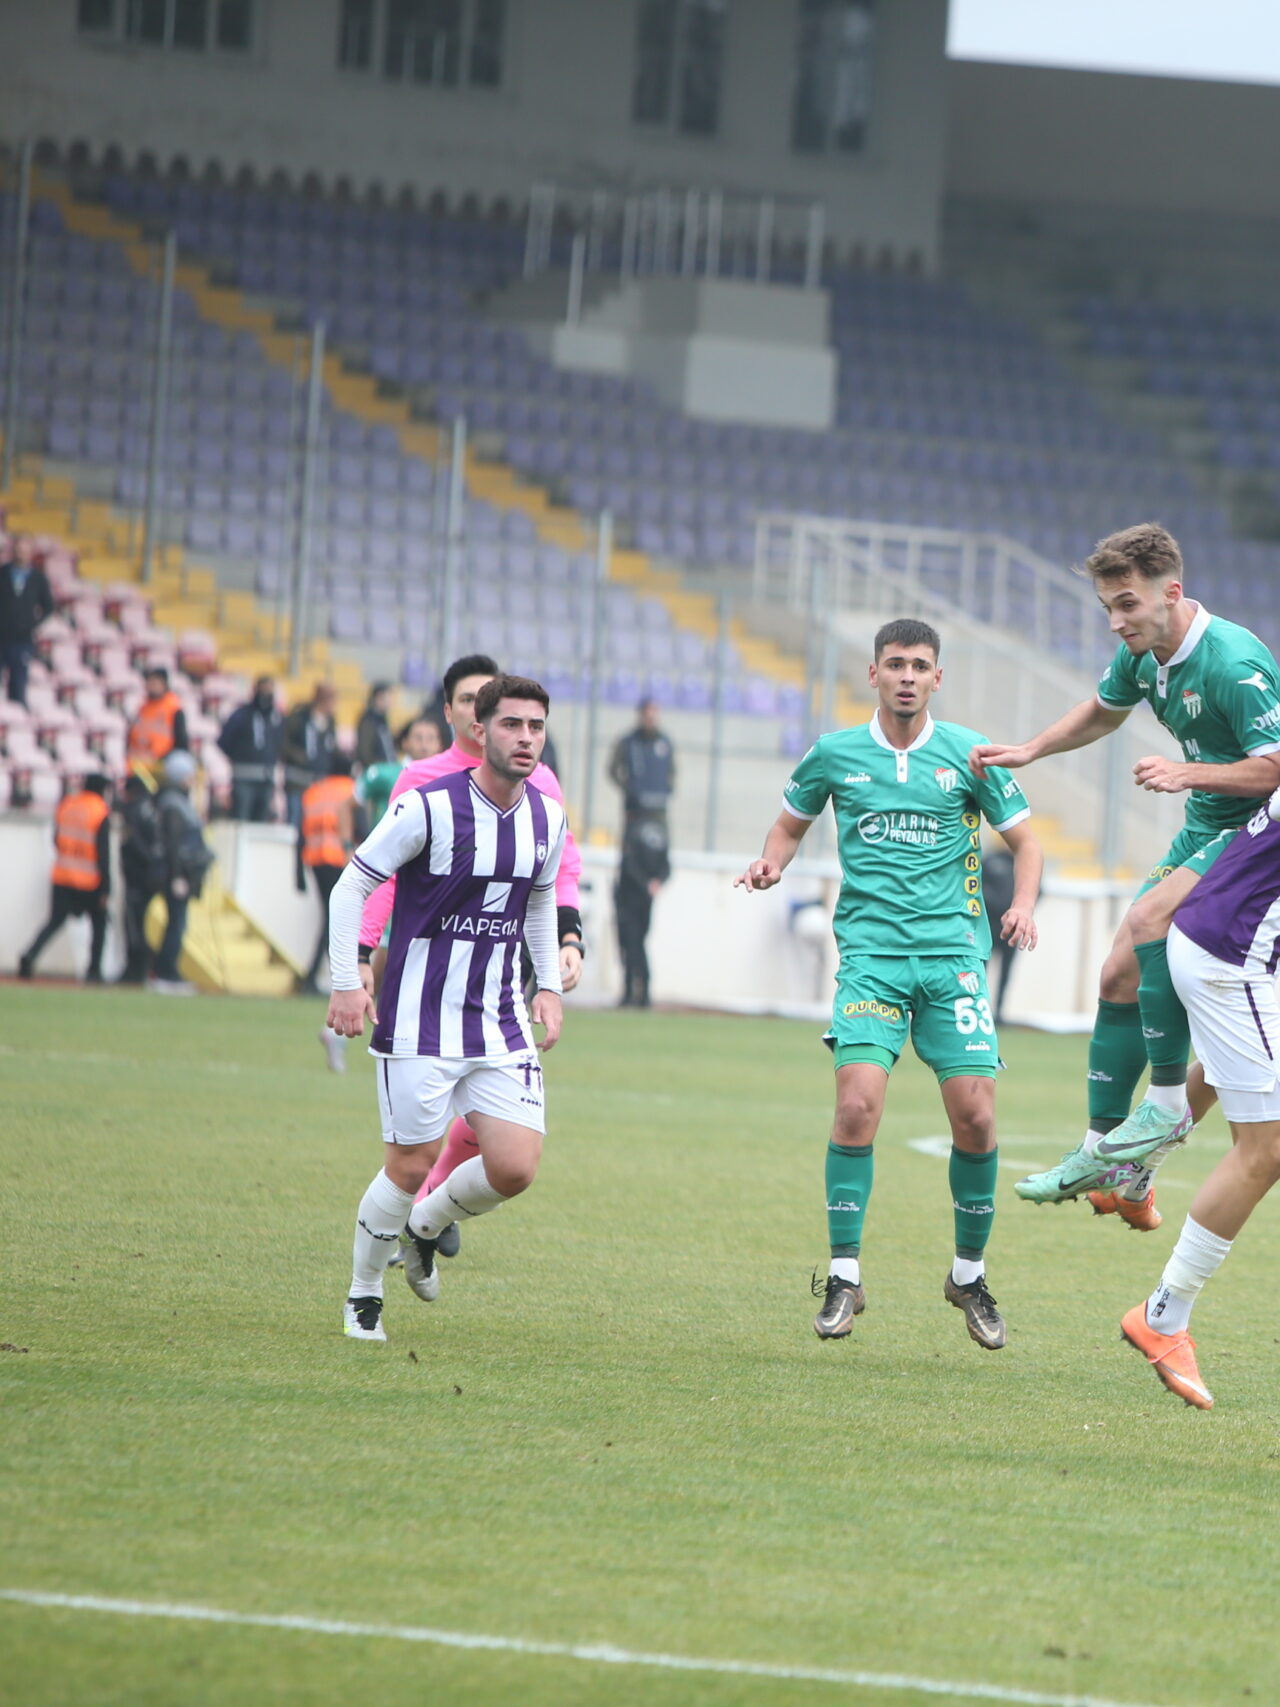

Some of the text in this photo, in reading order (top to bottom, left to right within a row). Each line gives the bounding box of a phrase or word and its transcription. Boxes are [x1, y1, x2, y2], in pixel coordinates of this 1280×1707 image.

[889, 812, 938, 831] TARIM
[890, 829, 921, 844] PEYZAJ
[845, 1001, 900, 1020] FURPA
[954, 996, 994, 1036] 53
